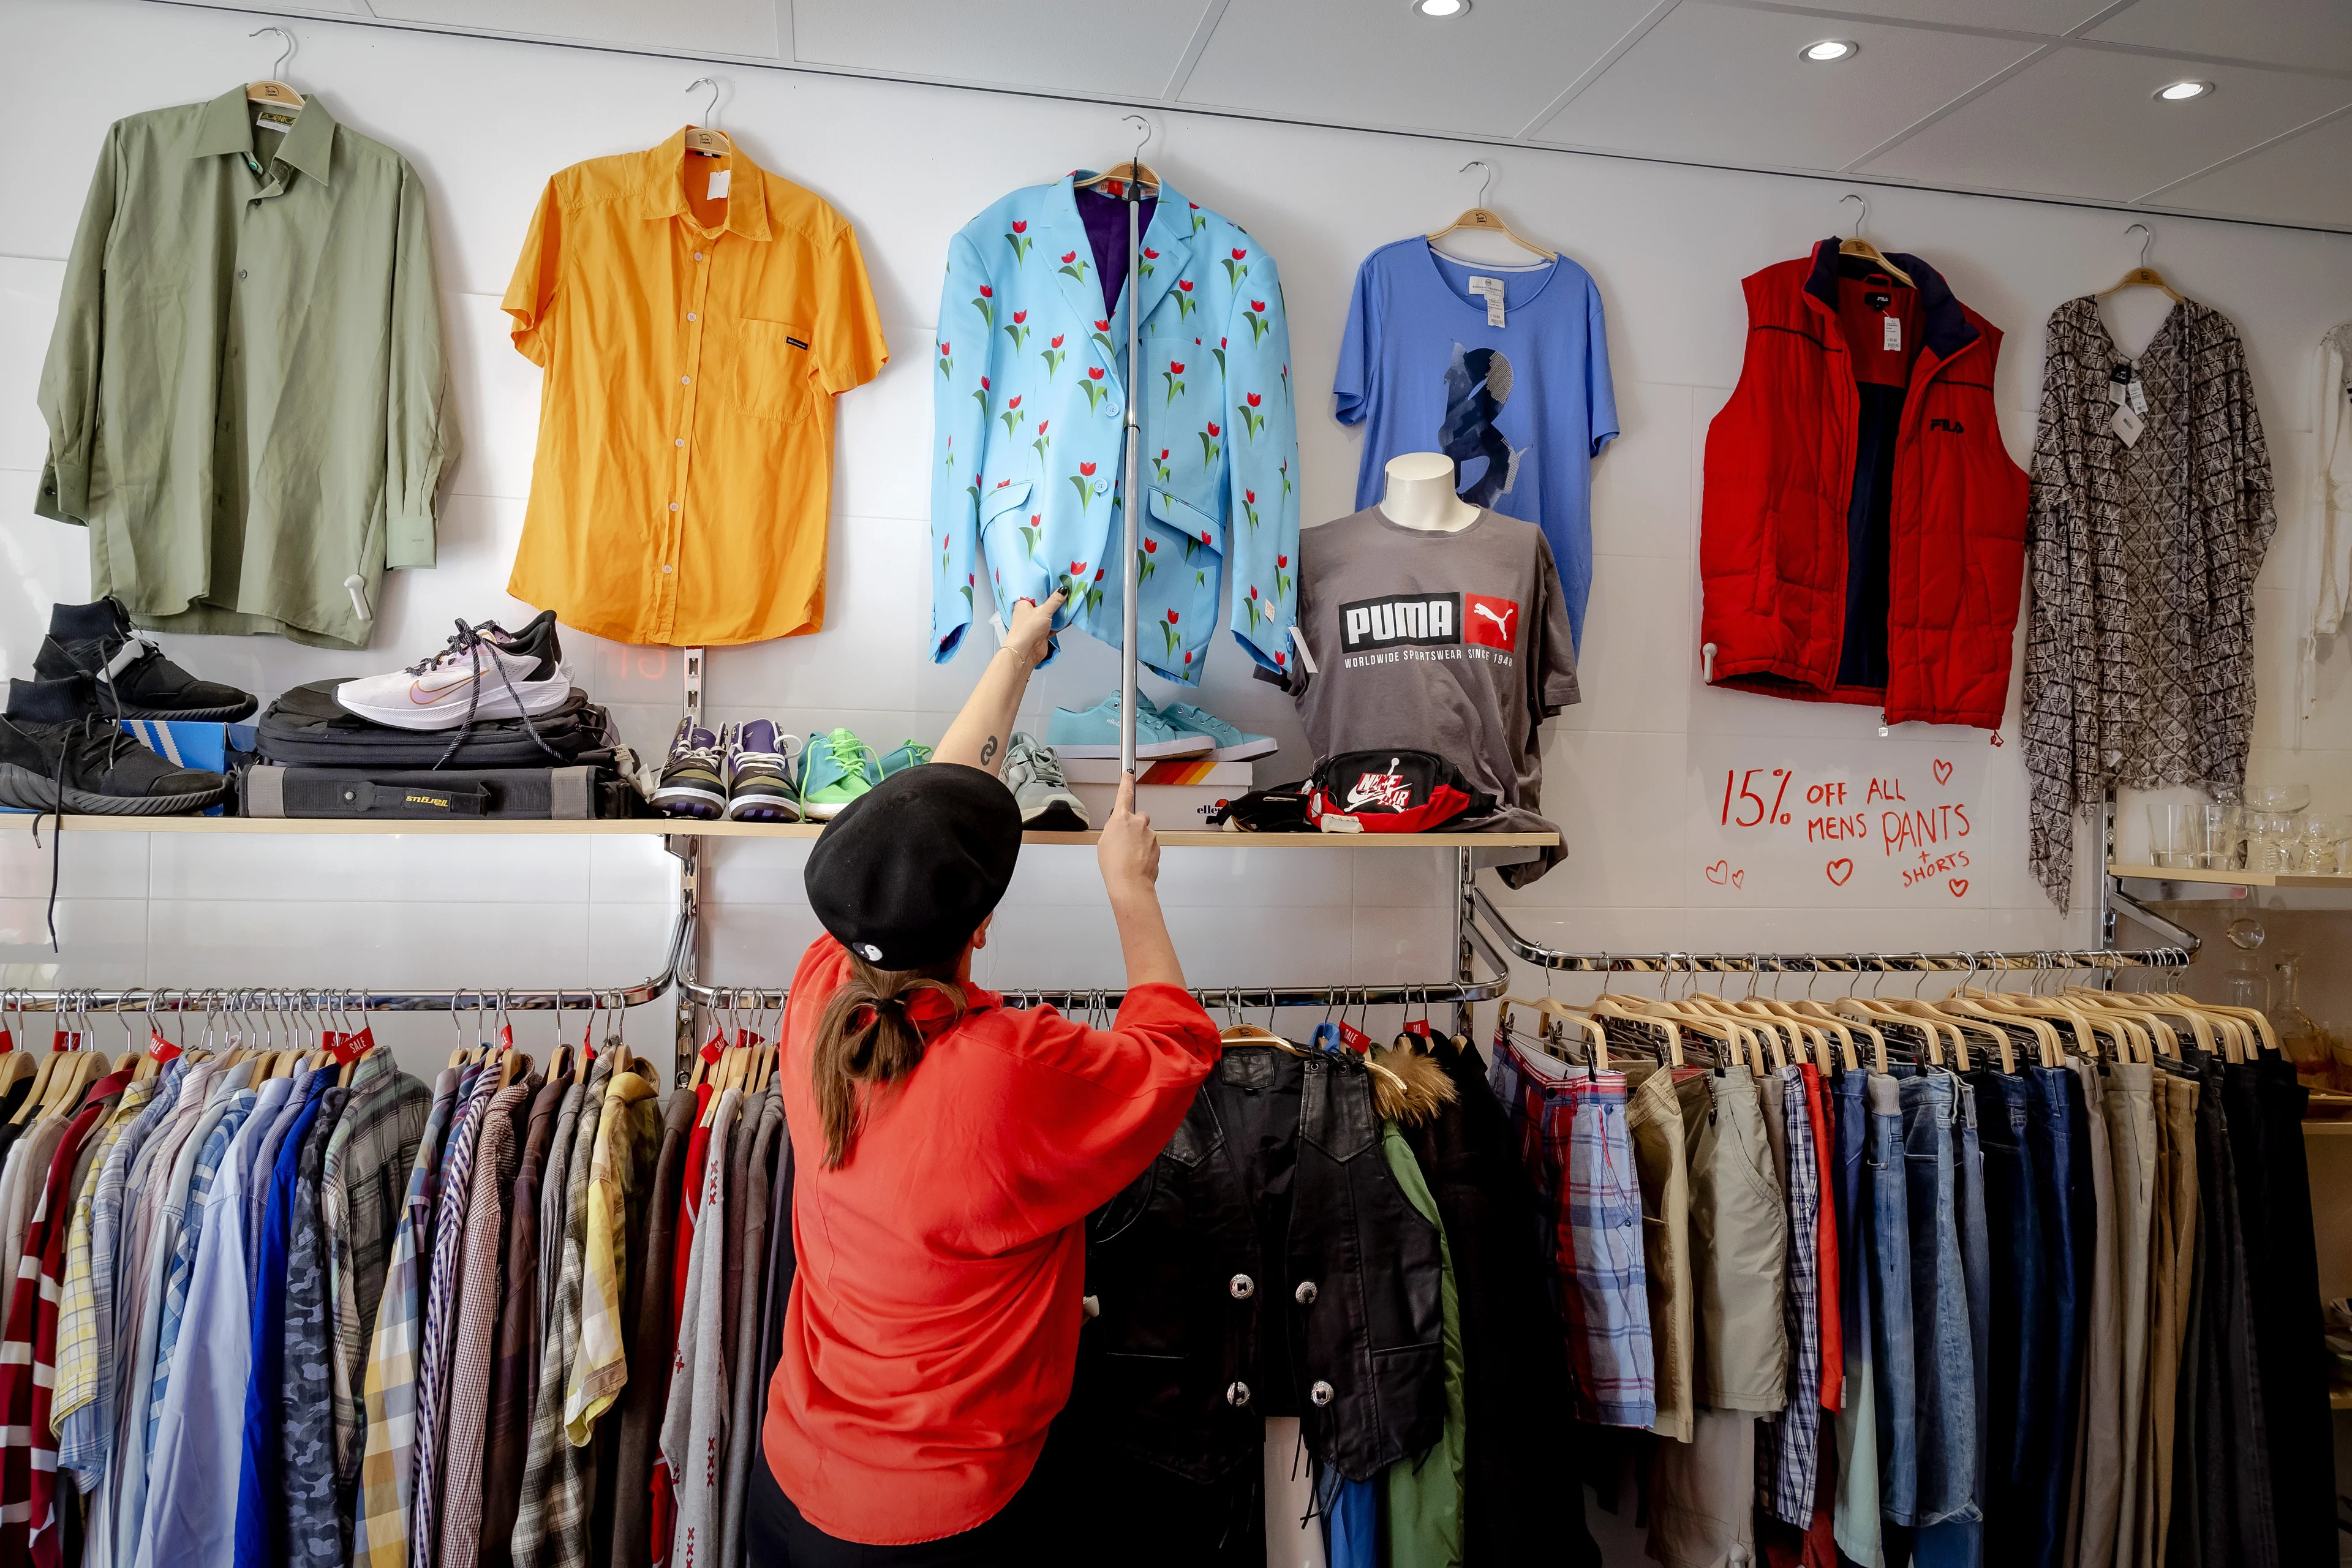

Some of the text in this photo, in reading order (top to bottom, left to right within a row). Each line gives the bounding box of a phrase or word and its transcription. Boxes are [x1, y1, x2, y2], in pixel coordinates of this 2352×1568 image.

[1930, 418, 1964, 434] FILA
[1347, 600, 1453, 644] PUMA
[1344, 649, 1513, 669] WORLDWIDE SPORTSWEAR SINCE 1948
[405, 796, 448, 807] Targus
[1378, 790, 1409, 806] AIR
[1721, 769, 1906, 827] 15% OFF ALL
[1807, 804, 1970, 857] MENS PANTS
[1902, 850, 1970, 888] SHORTS
[349, 1036, 366, 1054] SALE
[1344, 1028, 1359, 1044] SALE
[150, 1038, 164, 1055] SALE
